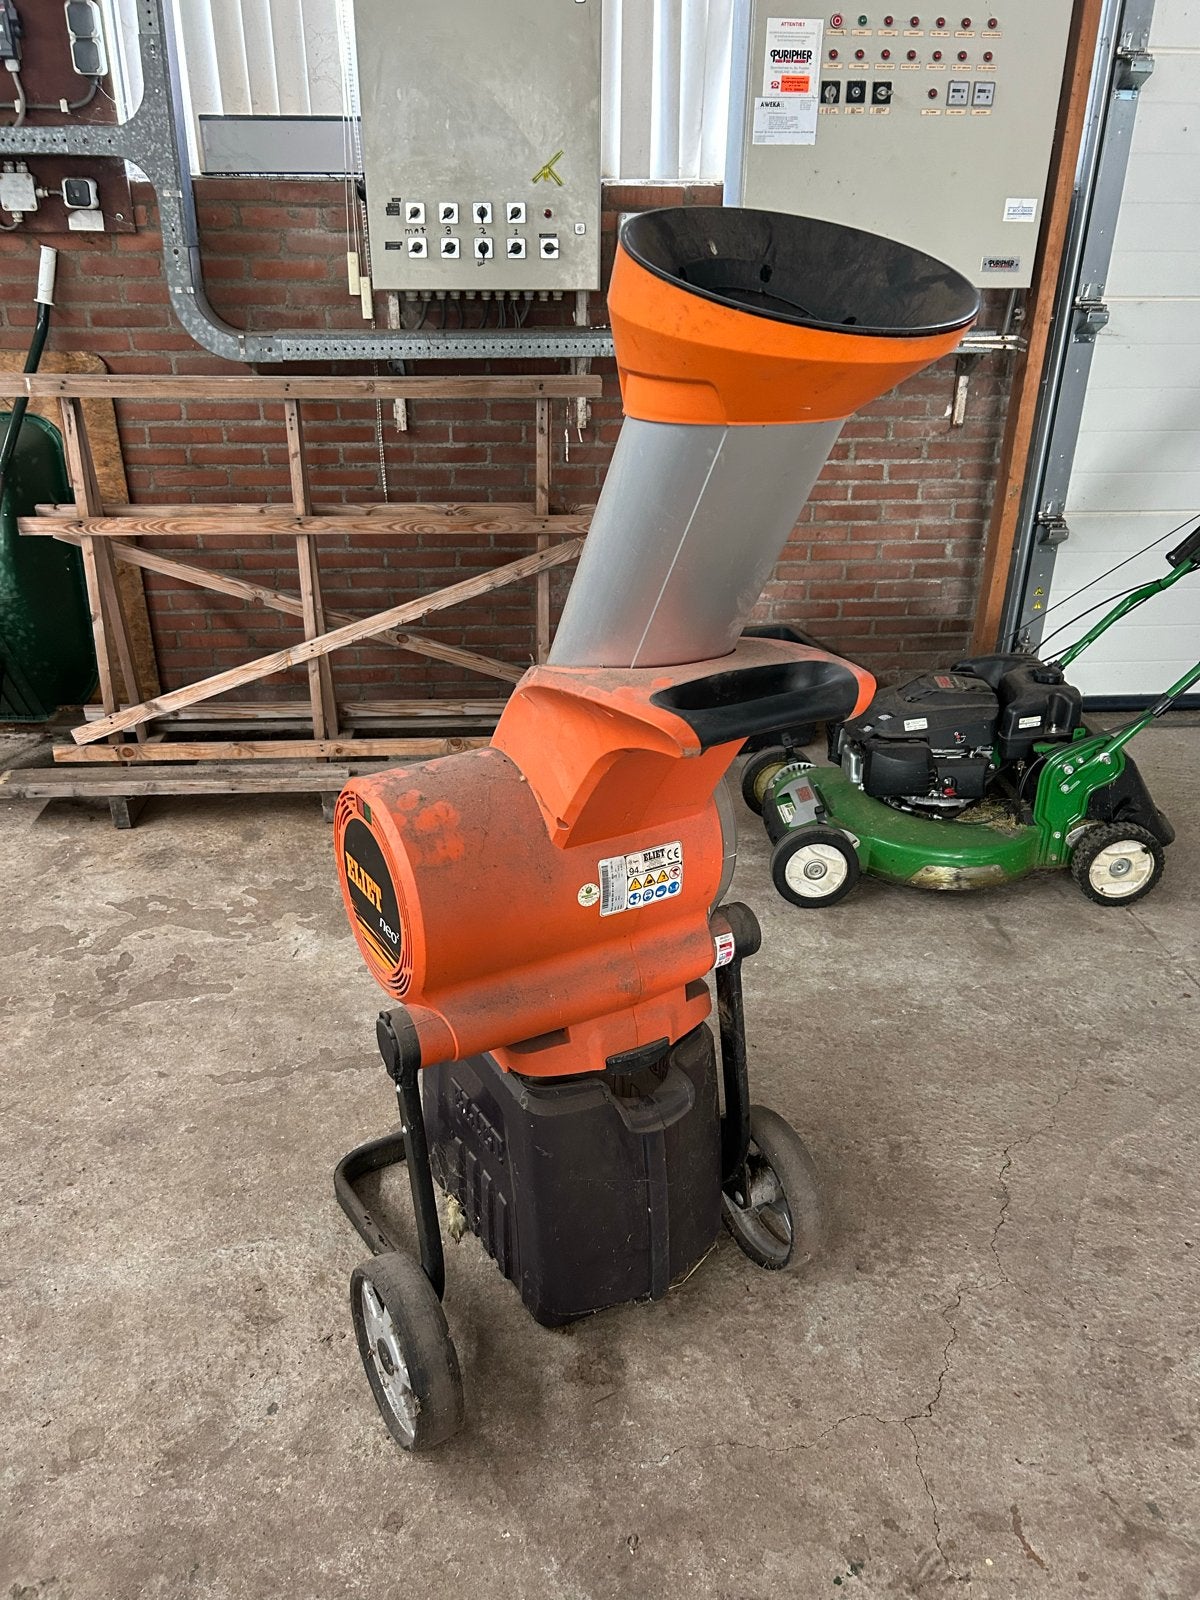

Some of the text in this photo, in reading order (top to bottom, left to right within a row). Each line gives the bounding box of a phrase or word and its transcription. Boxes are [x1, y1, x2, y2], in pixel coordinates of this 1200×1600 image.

[770, 49, 813, 63] PURIPHER
[445, 225, 452, 235] 3
[479, 227, 487, 235] 2
[643, 848, 666, 862] ELIET
[629, 867, 640, 876] 94
[345, 851, 383, 914] ELIET
